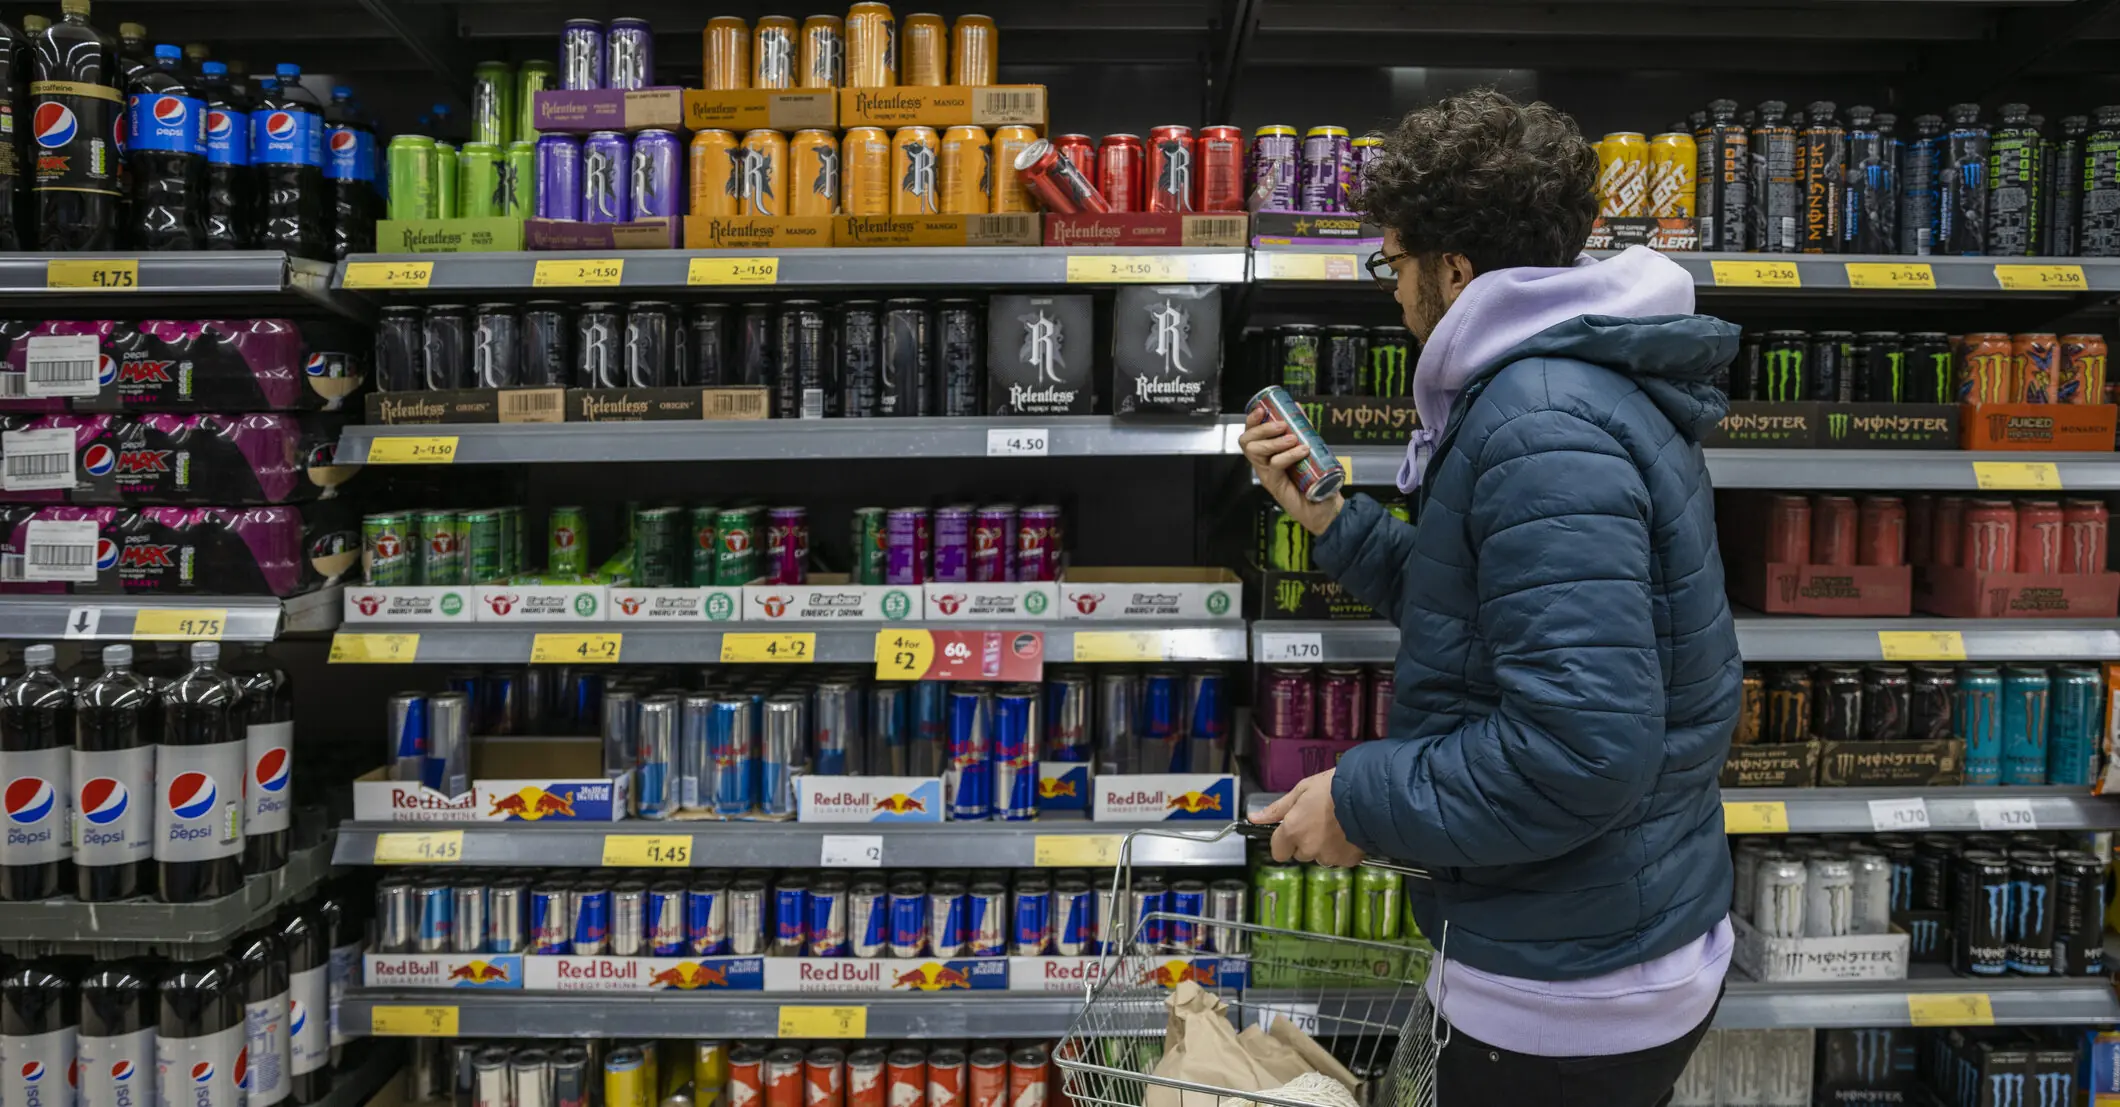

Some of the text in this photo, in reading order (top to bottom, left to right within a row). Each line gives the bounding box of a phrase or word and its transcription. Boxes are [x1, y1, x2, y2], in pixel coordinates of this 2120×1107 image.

[42, 85, 73, 93] caffeine
[542, 101, 588, 119] Relentless
[693, 102, 738, 119] Relentless
[856, 91, 923, 120] Relentless
[156, 127, 184, 138] pepsi
[1808, 143, 1825, 240] MONSTER
[710, 218, 775, 246] Relentless
[785, 228, 817, 236] MANGO
[848, 217, 915, 244] Relentless
[1054, 220, 1121, 246] Relentless
[402, 228, 462, 253] Relentless
[1647, 237, 1699, 249] ALERT
[387, 271, 427, 280] 2 £1.50
[578, 268, 618, 278] 2 £1.50
[732, 265, 774, 275] 2 £1.50
[1111, 264, 1118, 274] 2
[1755, 269, 1795, 280] 2 £2.50
[1891, 271, 1930, 281] 2 £2.50
[93, 271, 133, 287] £1.75
[2041, 272, 2080, 283] 2 £2.50
[123, 351, 148, 360] pepsi
[117, 360, 177, 383] MAX
[1135, 372, 1203, 404] Relentless
[1009, 382, 1076, 412] Relentless
[379, 399, 446, 424] Relentless
[582, 395, 650, 423] Relentless
[659, 402, 691, 410] ORIGIN
[1717, 414, 1808, 431] MONSTER
[1853, 414, 1949, 432] MONSTER
[2007, 416, 2053, 429] JUICED
[1729, 432, 1791, 440] ENERGY
[1869, 433, 1932, 441] ENERGY
[413, 445, 453, 455] 2 £1.50
[1007, 438, 1044, 450] £4.50
[115, 450, 174, 473] MAX
[125, 535, 150, 544] pepsi
[118, 544, 177, 567] MAX
[649, 609, 698, 617] ENERGY DRINK
[801, 609, 864, 617] ENERGY DRINK
[179, 619, 219, 637] £1.75
[577, 641, 616, 655] 4 £2
[766, 641, 806, 655] 4 £2
[893, 637, 920, 649] 4 for
[944, 642, 972, 658] 60p
[1287, 645, 1319, 657] £1.70
[894, 652, 915, 670] £2
[1726, 757, 1800, 770] MONSTER
[1857, 752, 1937, 766] MONSTER
[814, 793, 870, 806] Red Bull
[1107, 791, 1164, 805] Red Bull
[7, 828, 52, 846] pepsi
[83, 829, 125, 845] pepsi
[169, 825, 212, 842] pepsi
[418, 842, 457, 858] £1.45
[647, 846, 687, 862] £1.45
[866, 847, 880, 860] £2
[1807, 951, 1893, 965] MONSTER
[375, 961, 439, 975] Red Bull
[558, 961, 637, 978] Red Bull
[801, 963, 880, 981] Red Bull
[1045, 961, 1080, 978] Red
